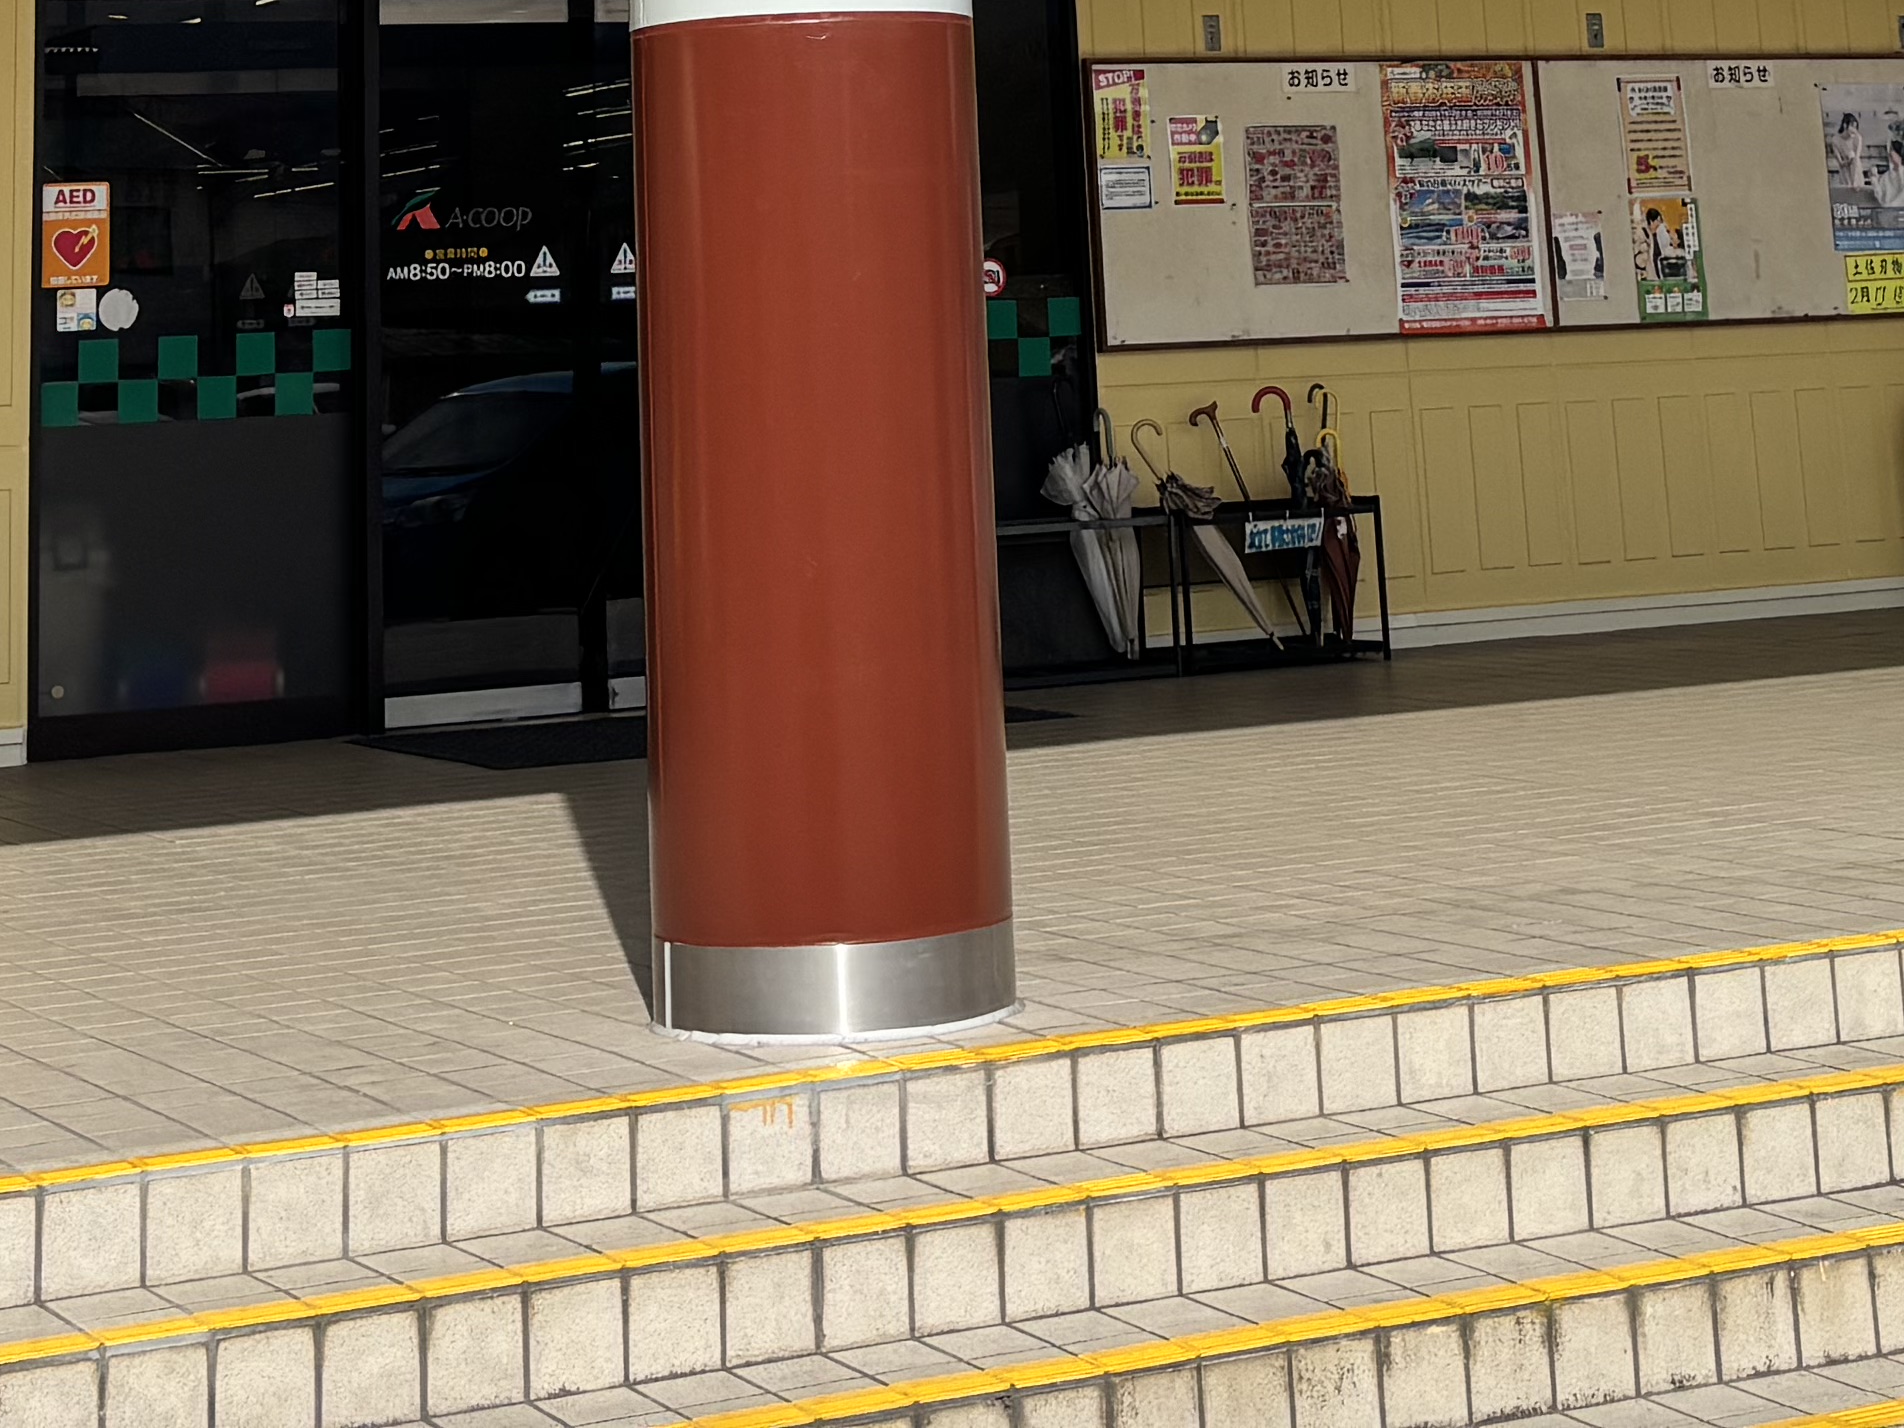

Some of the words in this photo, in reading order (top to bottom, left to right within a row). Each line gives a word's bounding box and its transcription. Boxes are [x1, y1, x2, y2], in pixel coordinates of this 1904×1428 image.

[1288, 69, 1349, 88] お知らせ
[1713, 66, 1770, 83] お知らせ
[54, 188, 96, 205] AED
